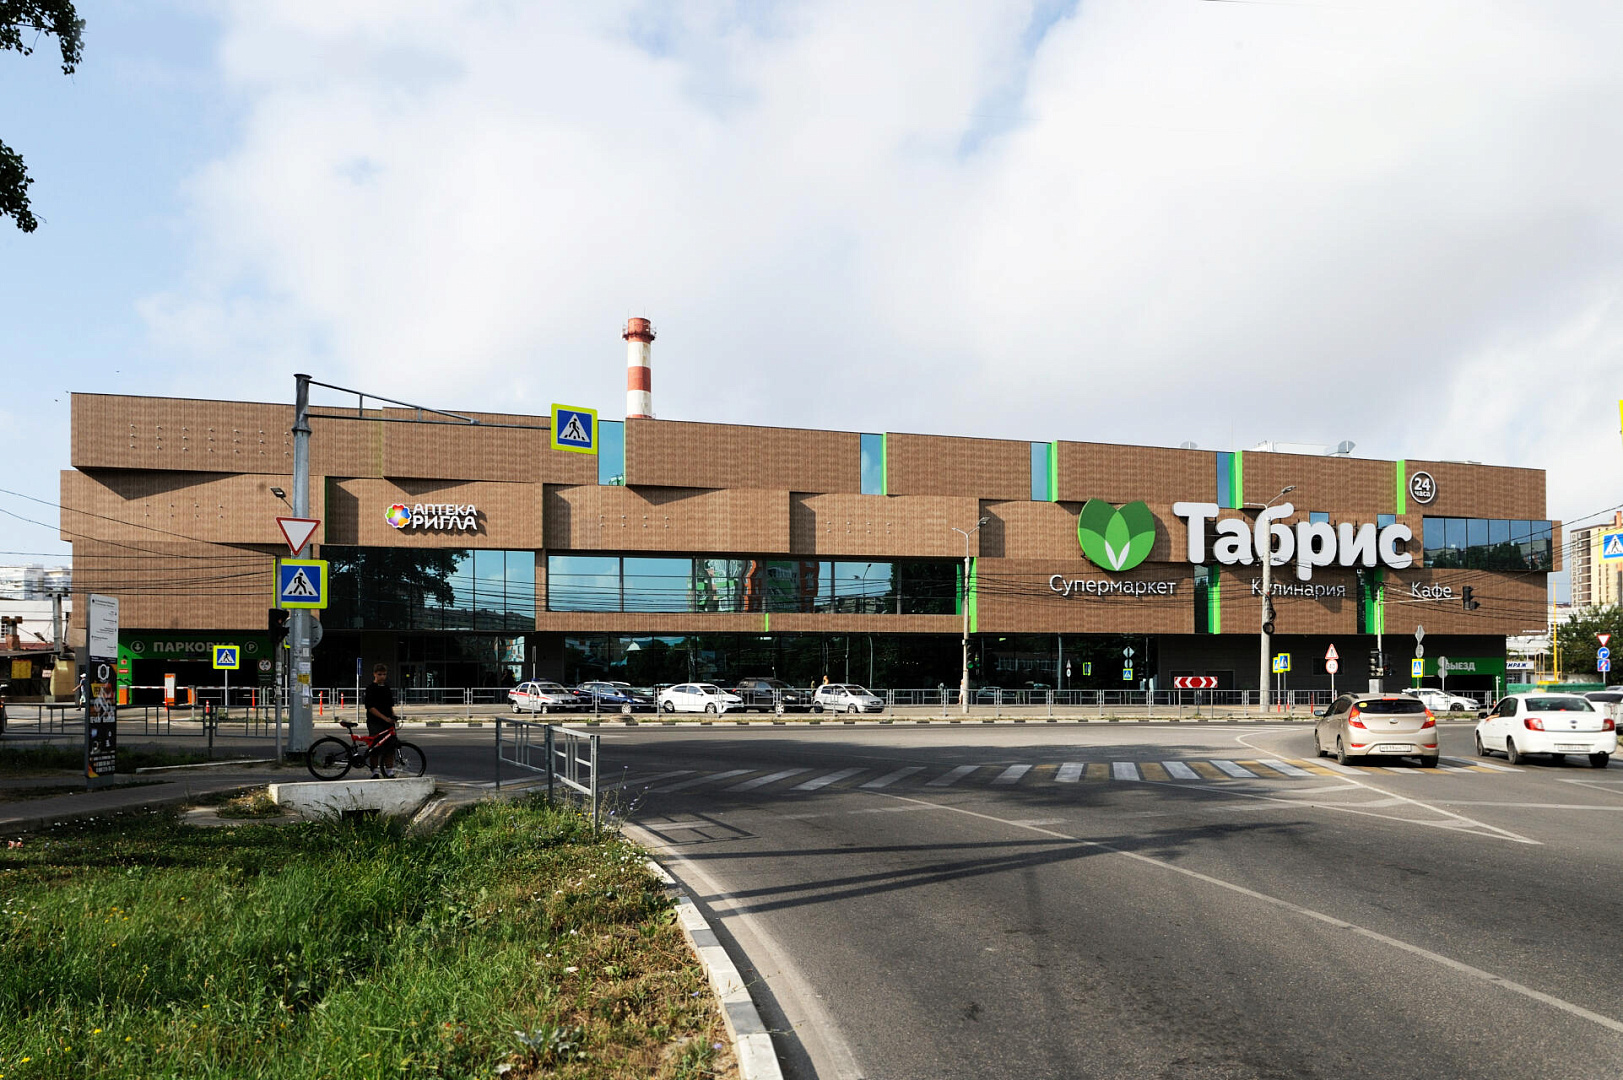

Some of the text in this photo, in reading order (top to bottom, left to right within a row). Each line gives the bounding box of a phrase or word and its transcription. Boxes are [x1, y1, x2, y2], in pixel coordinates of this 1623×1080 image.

[1414, 477, 1431, 491] 24
[412, 503, 478, 516] АПТЕКА
[412, 515, 478, 530] РИГЛА
[1172, 502, 1413, 581] Табрис
[1049, 574, 1177, 598] Супермаркет
[1251, 578, 1346, 600] Клинария
[1411, 581, 1452, 602] Кафе
[153, 641, 235, 652] ПАРКОВ
